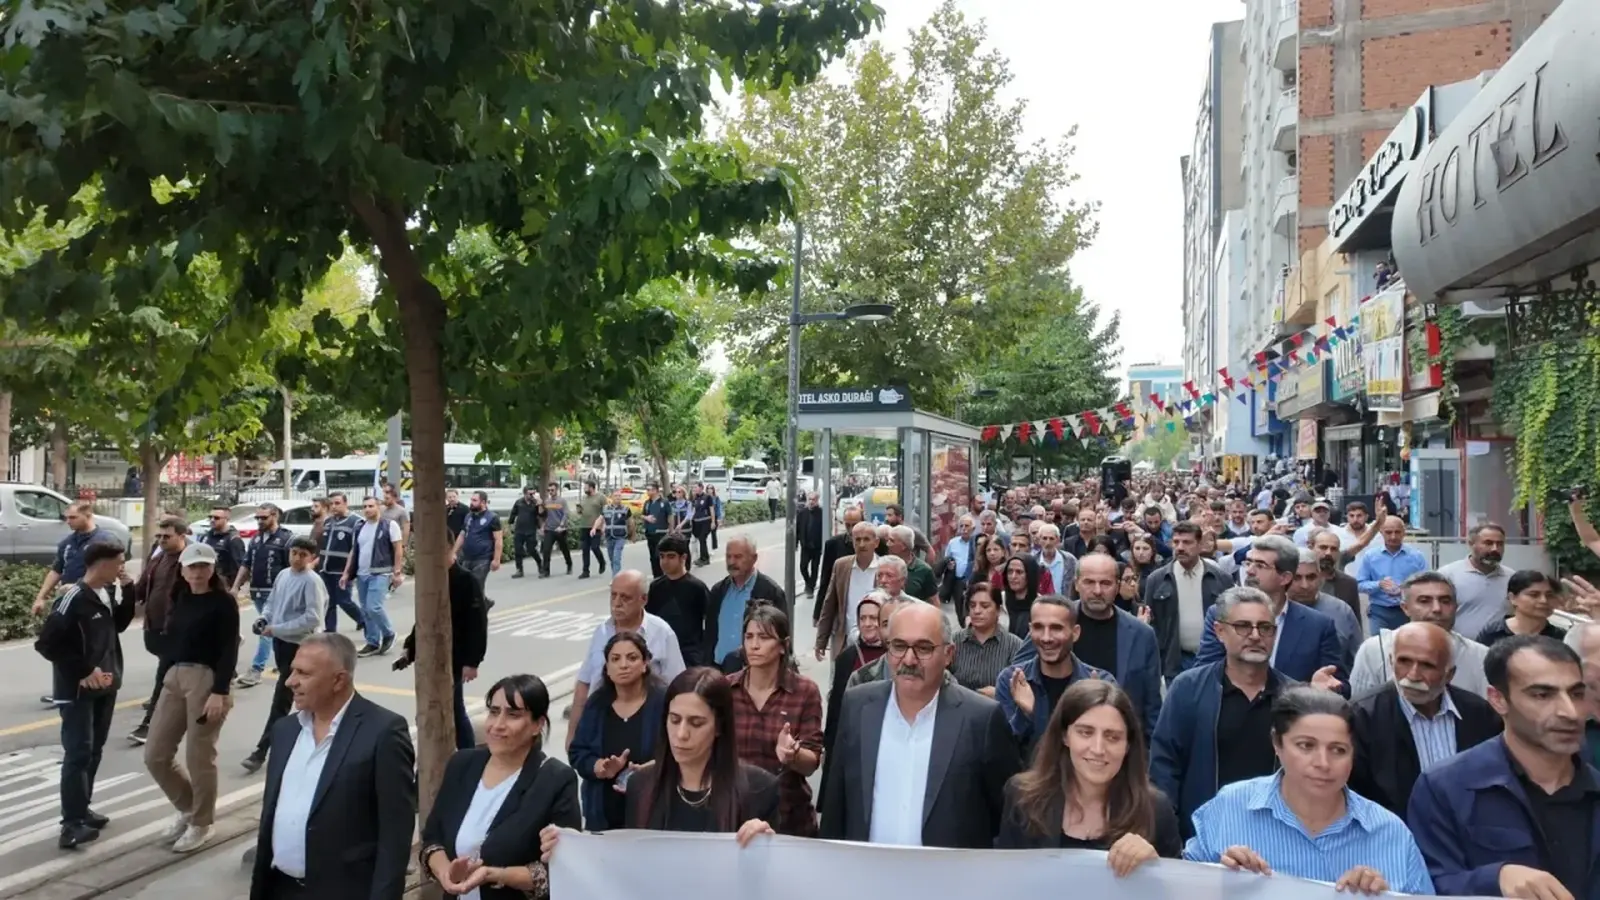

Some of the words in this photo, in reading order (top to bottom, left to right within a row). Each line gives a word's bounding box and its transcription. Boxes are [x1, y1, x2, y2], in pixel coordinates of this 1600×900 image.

[1418, 61, 1568, 247] HOTEL
[818, 391, 840, 403] ASKO
[841, 390, 873, 402] DURAĞI
